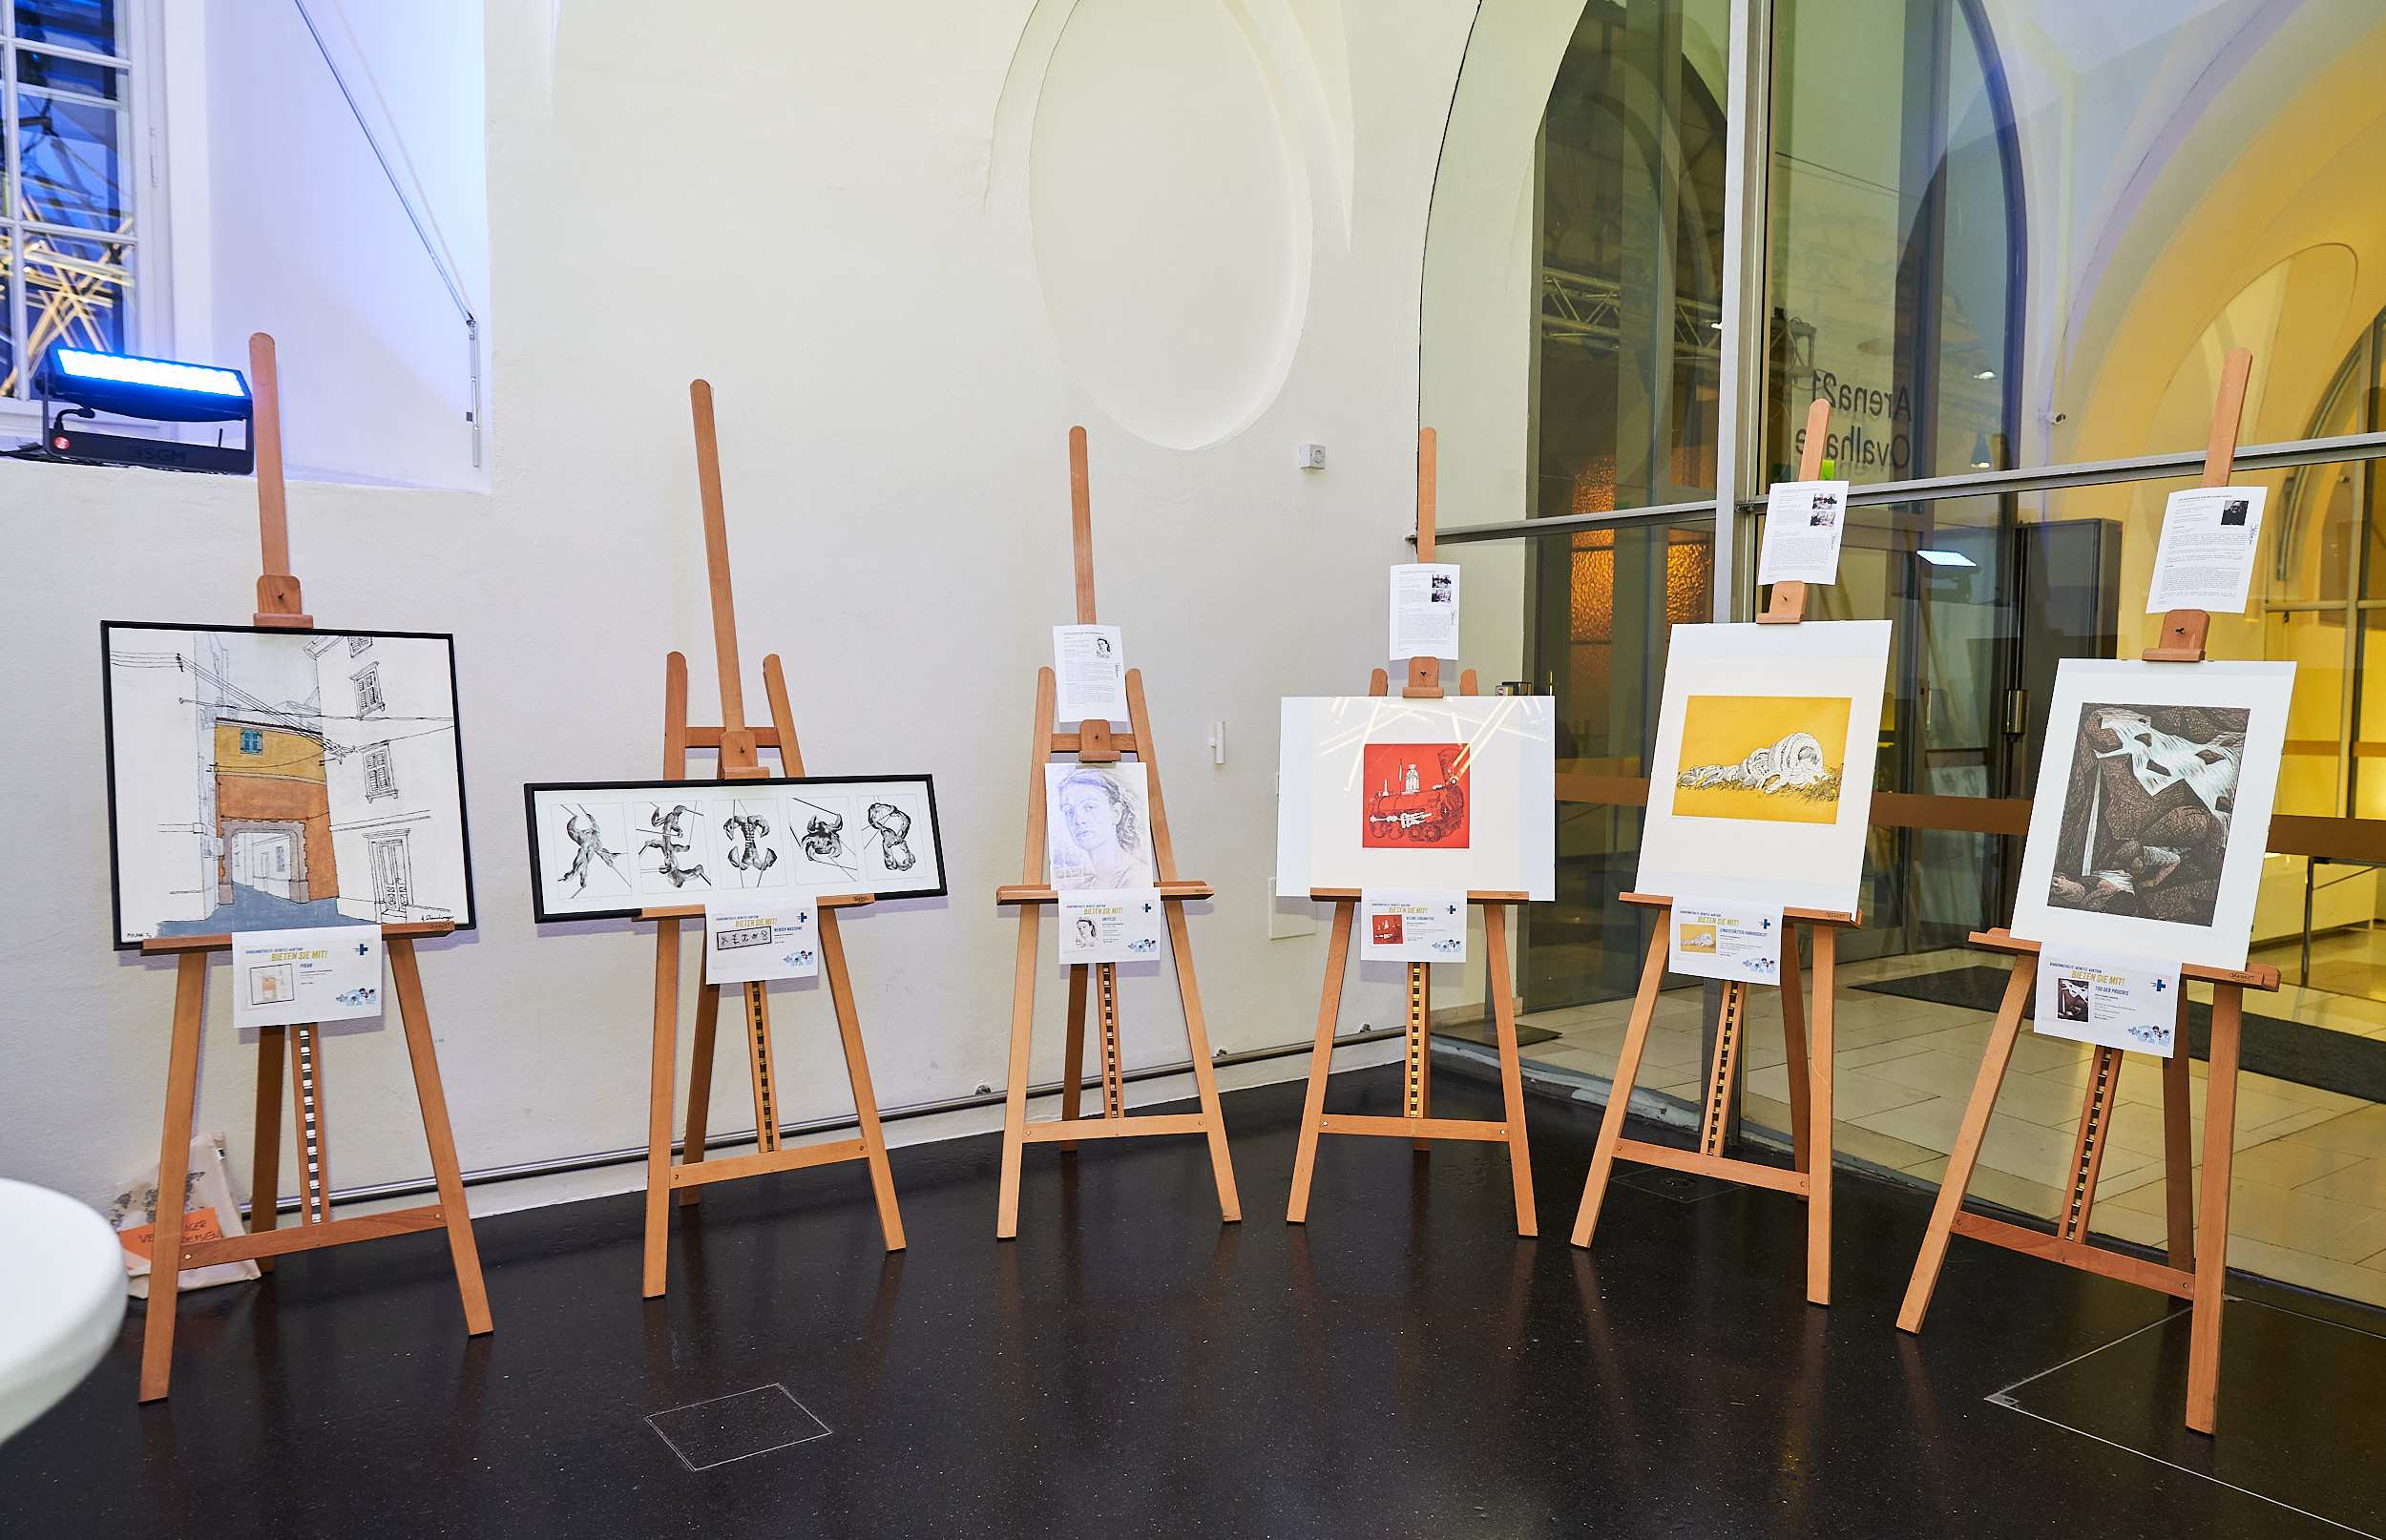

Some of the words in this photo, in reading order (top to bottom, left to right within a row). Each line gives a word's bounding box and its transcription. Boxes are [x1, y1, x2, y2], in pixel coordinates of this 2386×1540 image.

[271, 952, 298, 962] BIETEN
[298, 951, 311, 960] SIE
[311, 950, 328, 959] MIT!
[2071, 970, 2096, 981] BIETEN
[2097, 973, 2109, 983] SIE
[2110, 975, 2125, 986] MIT!
